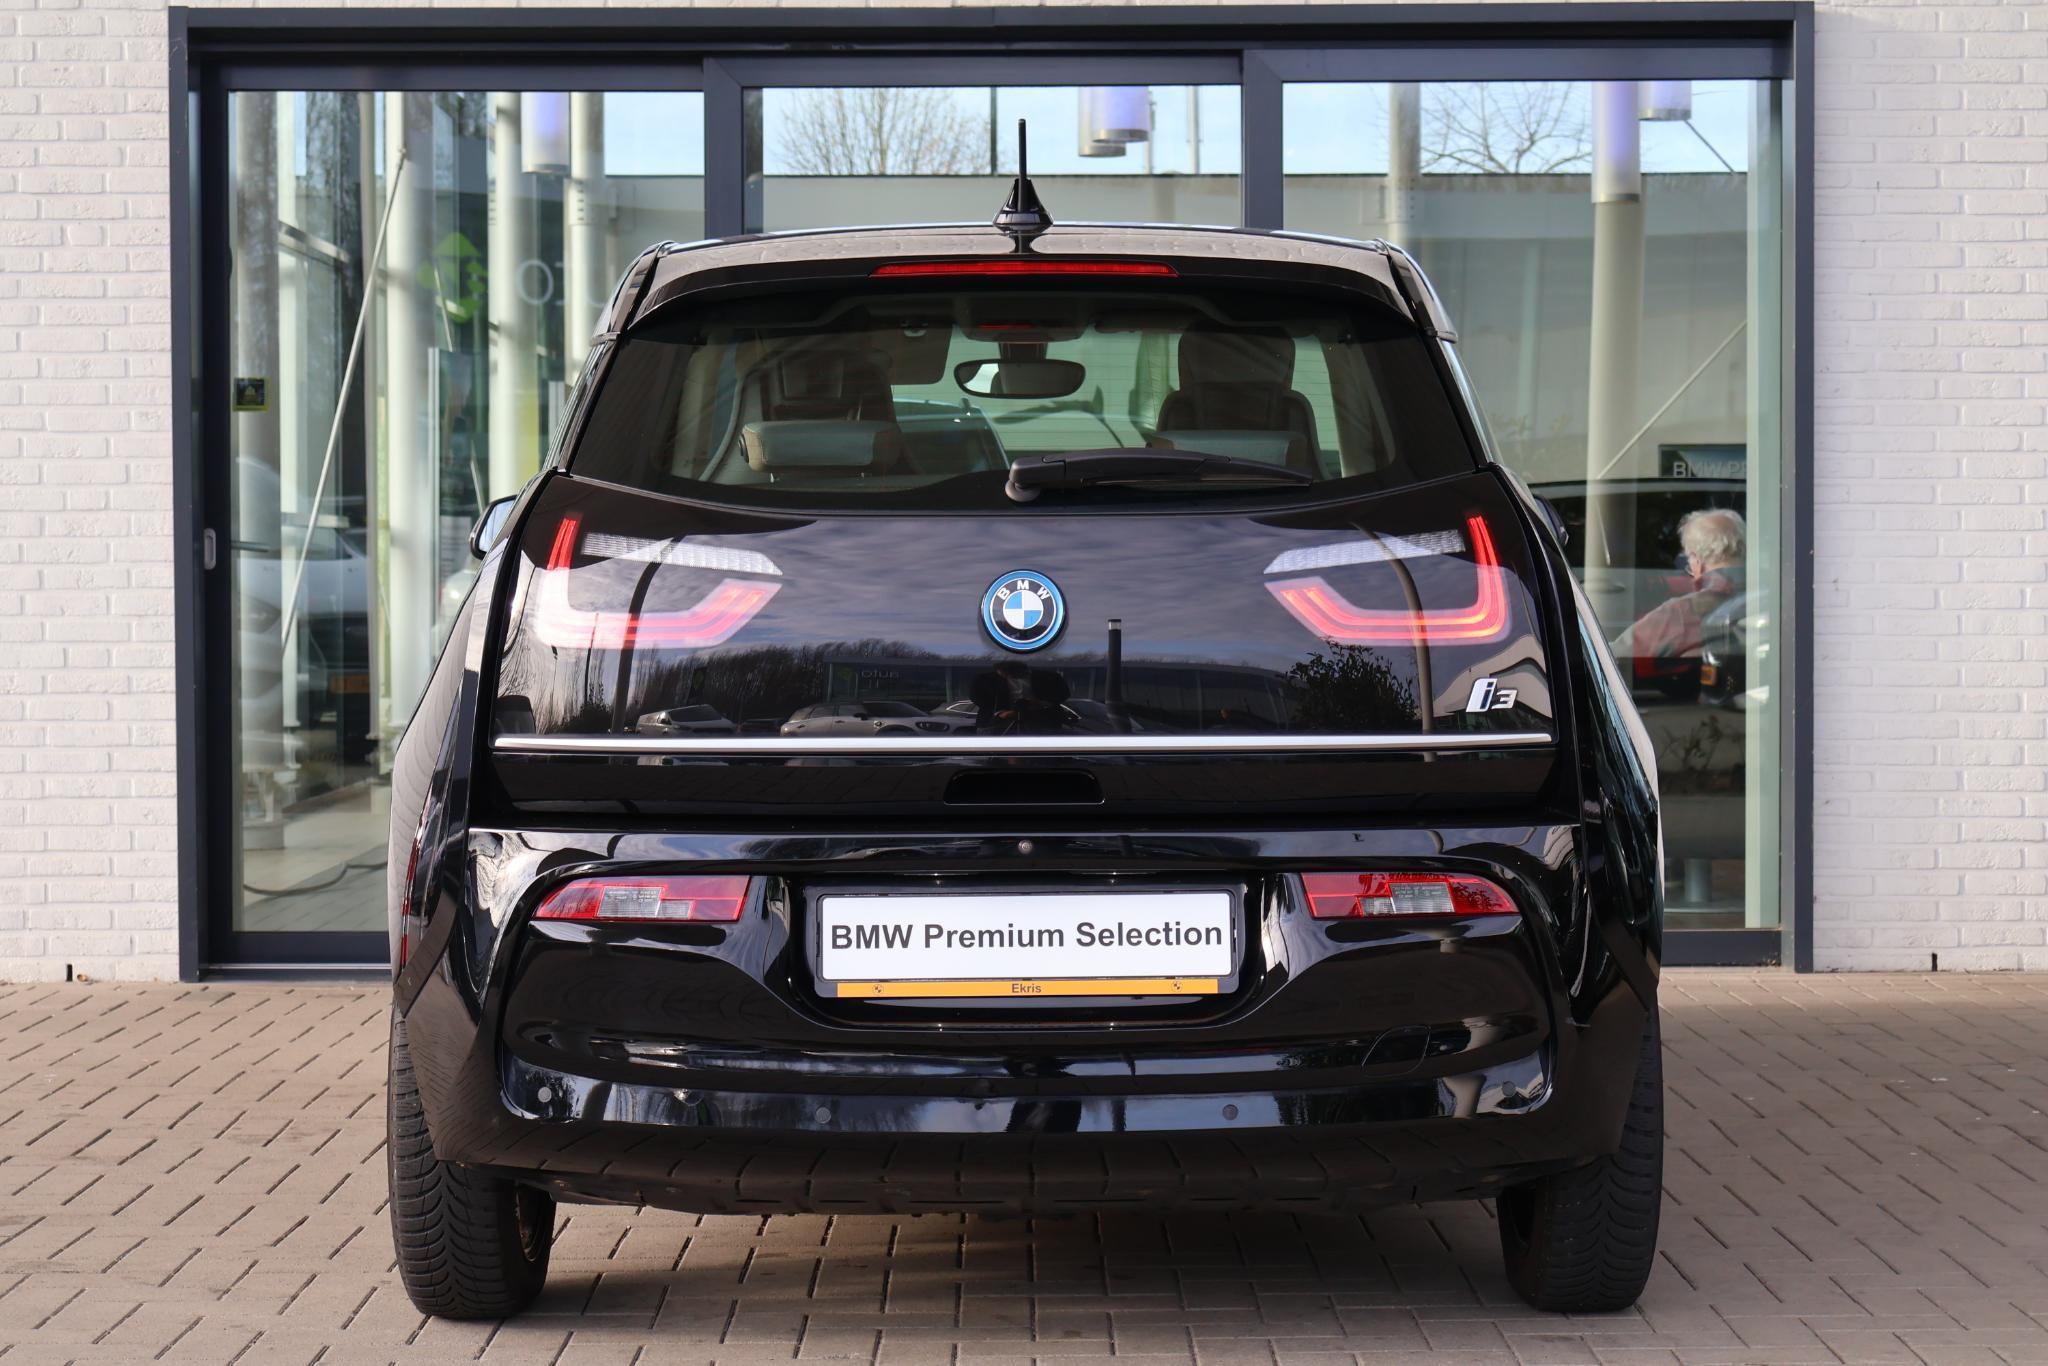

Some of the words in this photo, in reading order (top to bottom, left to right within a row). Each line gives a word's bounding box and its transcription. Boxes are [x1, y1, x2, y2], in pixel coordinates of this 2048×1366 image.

[1673, 461, 1722, 477] BMW
[996, 580, 1051, 600] BMW
[1466, 678, 1518, 712] i3
[831, 924, 913, 949] BMW
[924, 923, 1065, 948] Premium
[1076, 921, 1222, 947] Selection
[1011, 983, 1042, 993] Ekris
